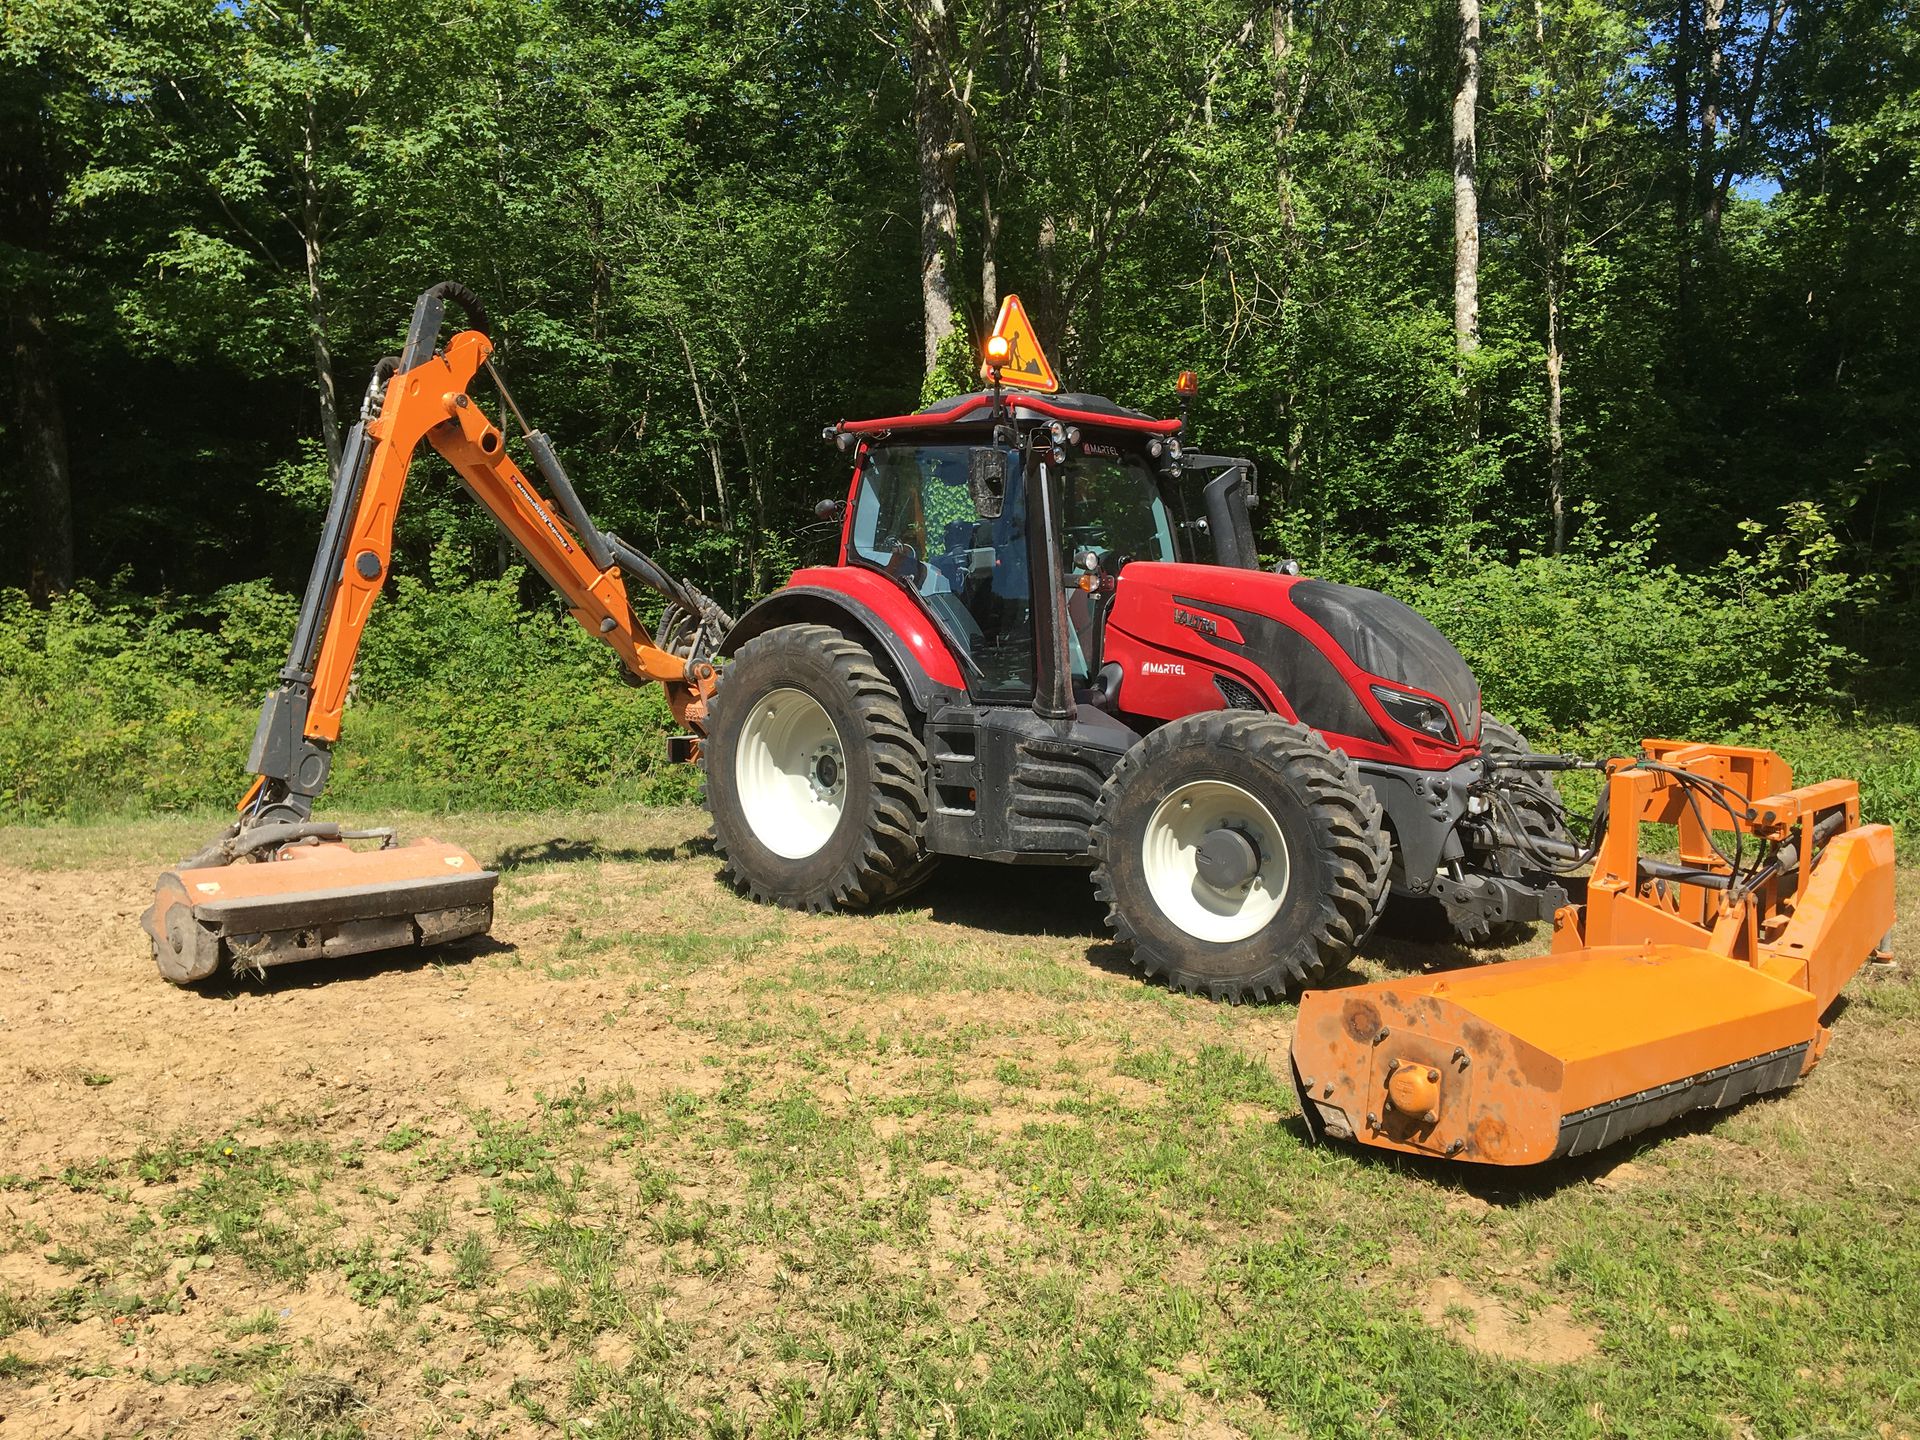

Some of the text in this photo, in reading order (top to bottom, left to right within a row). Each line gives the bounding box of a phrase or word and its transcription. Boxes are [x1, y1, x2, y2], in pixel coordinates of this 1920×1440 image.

[1090, 443, 1119, 456] MARTEL
[1174, 608, 1217, 636] VALTRA
[1150, 663, 1186, 676] MARTEL
